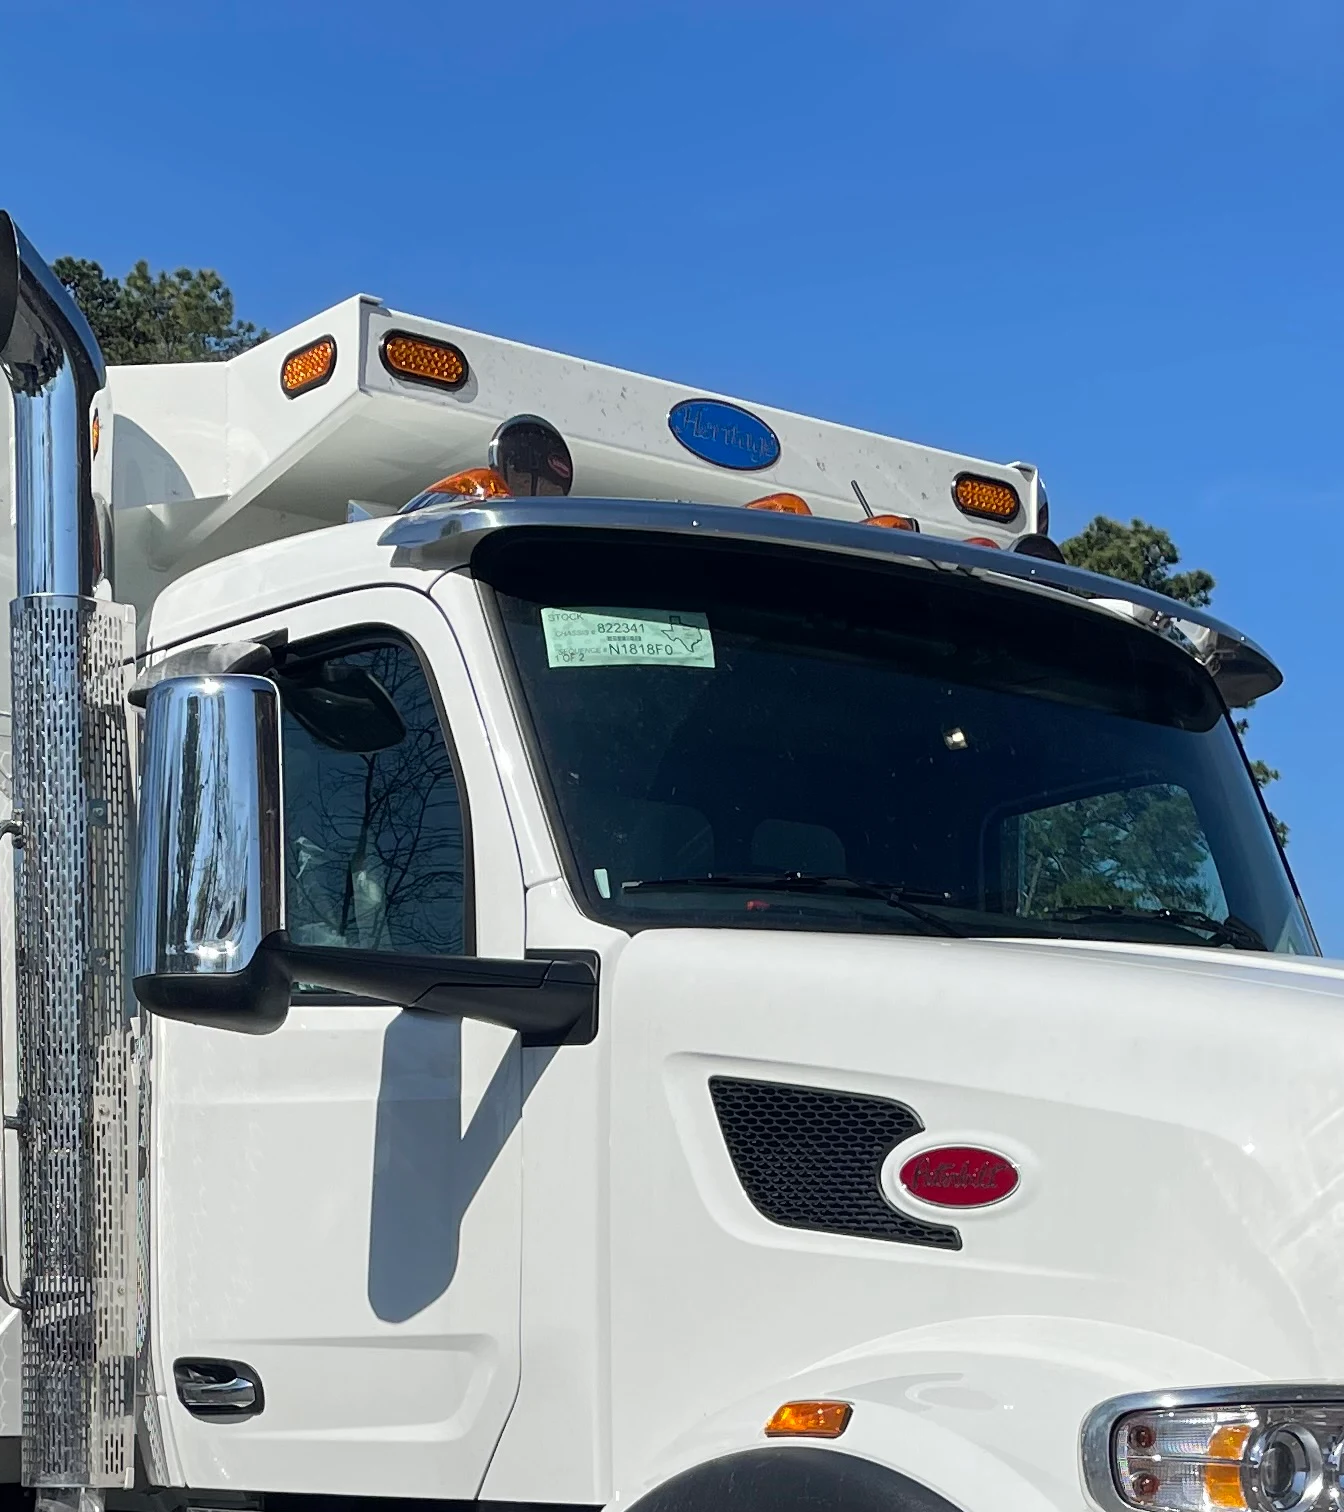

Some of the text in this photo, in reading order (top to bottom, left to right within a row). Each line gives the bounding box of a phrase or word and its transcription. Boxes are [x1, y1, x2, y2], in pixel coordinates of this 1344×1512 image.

[547, 612, 585, 622] STOCK
[597, 622, 646, 635] 822341
[579, 652, 586, 662] 2
